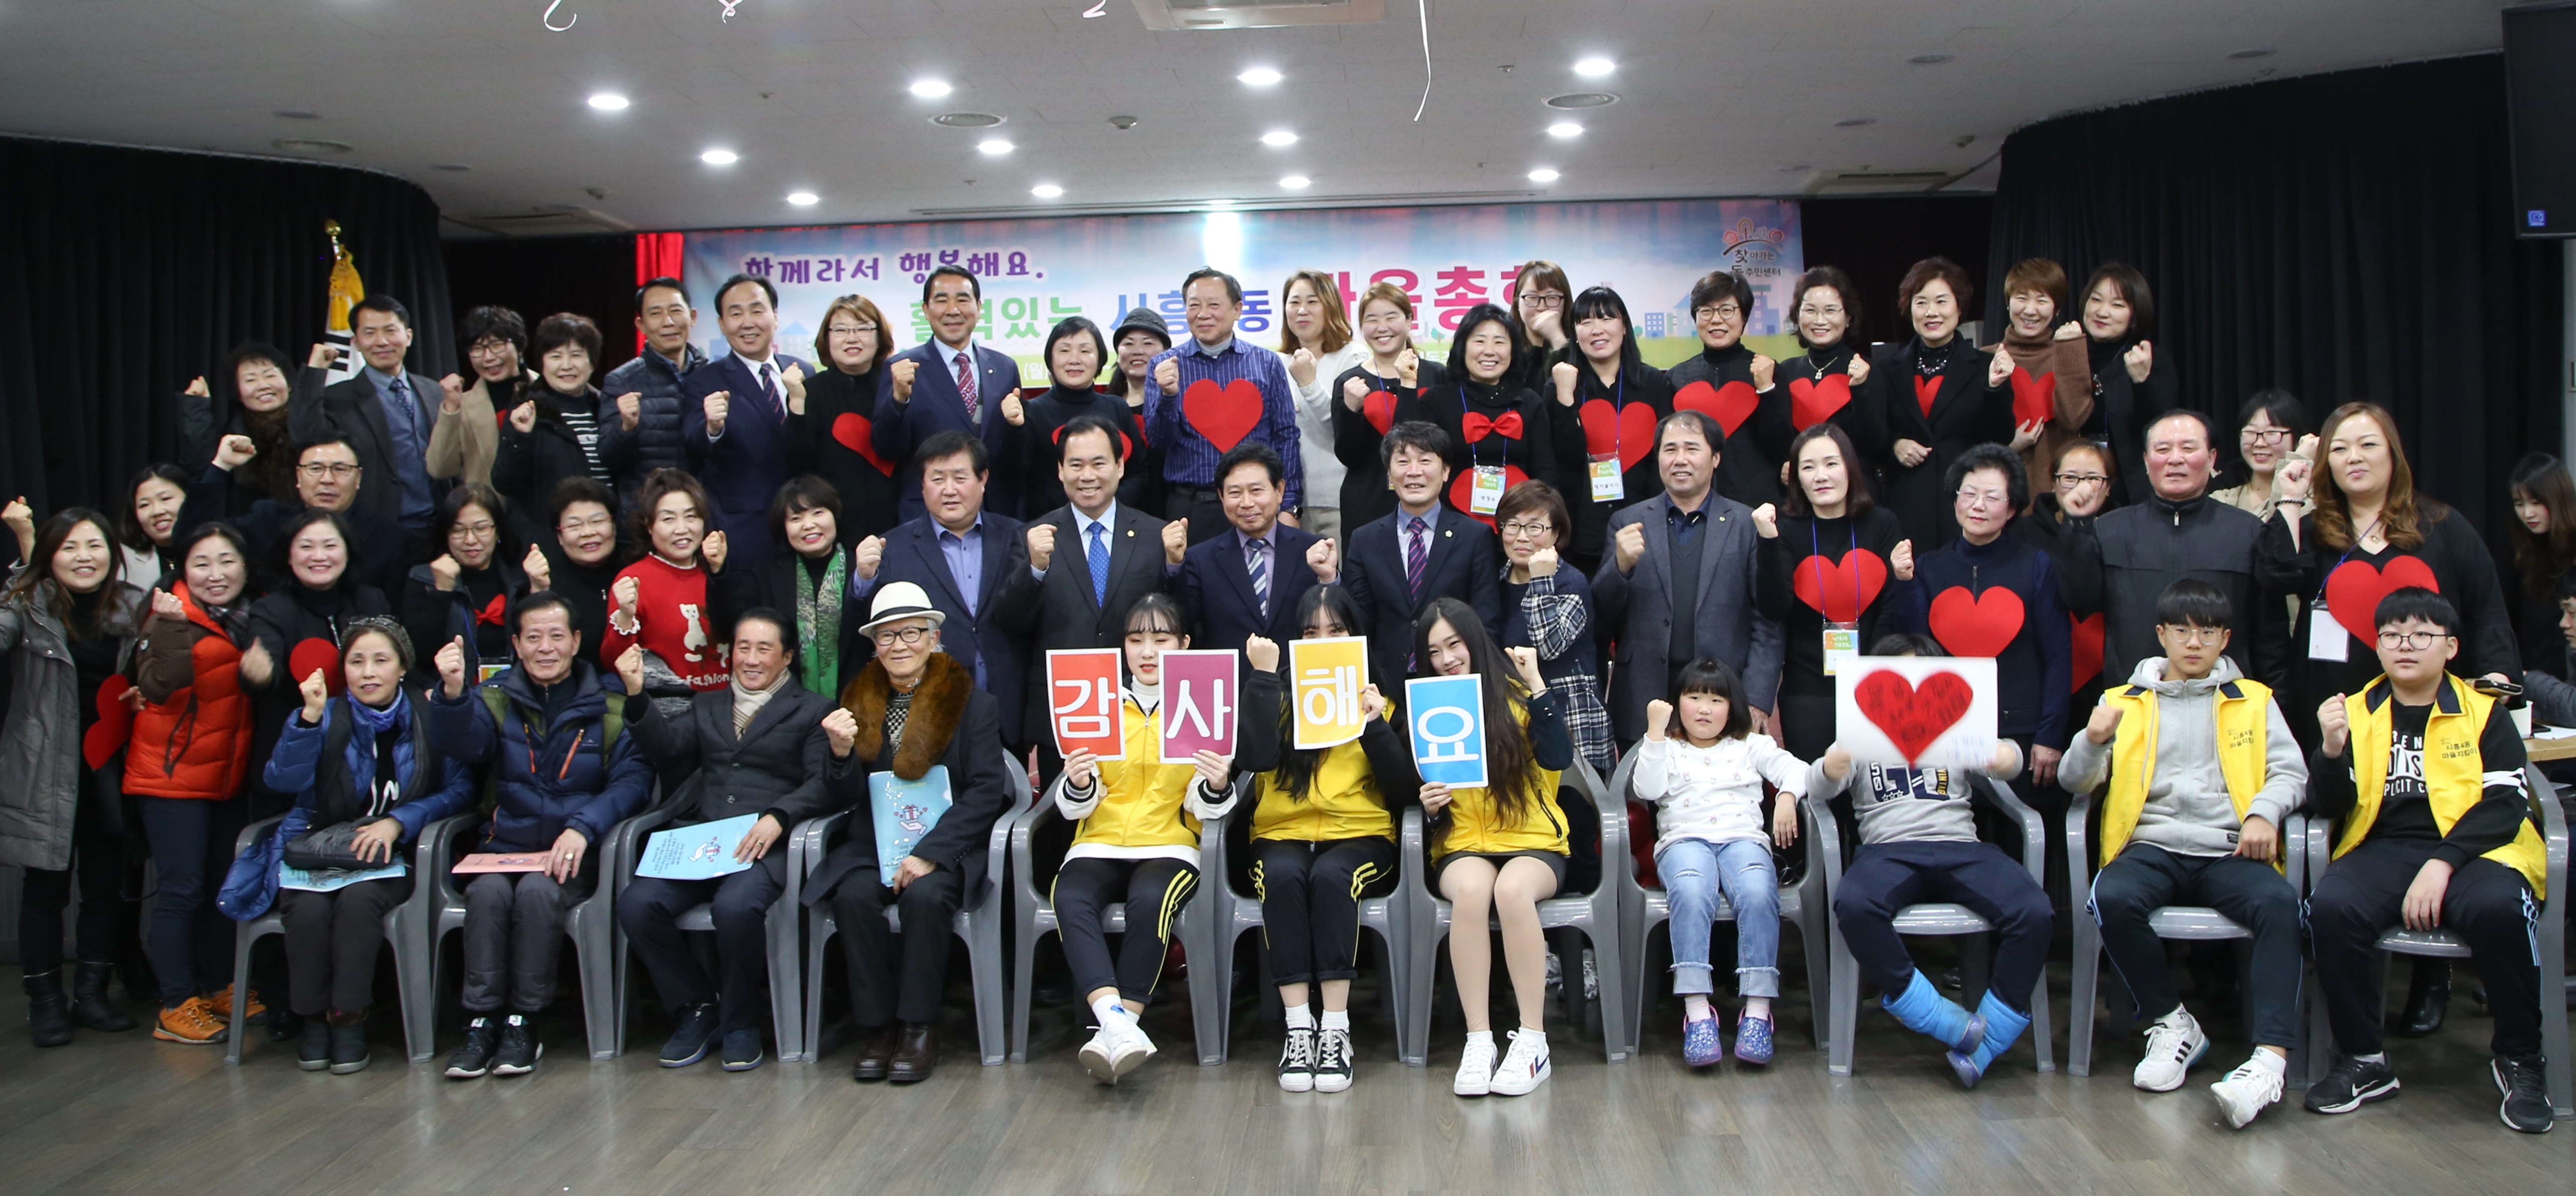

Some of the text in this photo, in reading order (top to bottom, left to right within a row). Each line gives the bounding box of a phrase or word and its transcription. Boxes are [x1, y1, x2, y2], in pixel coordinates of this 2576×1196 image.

[1054, 665, 1480, 765] 감 사 해 요
[2445, 741, 2471, 750] 시흥4동
[2441, 747, 2478, 759] 마을지킴이
